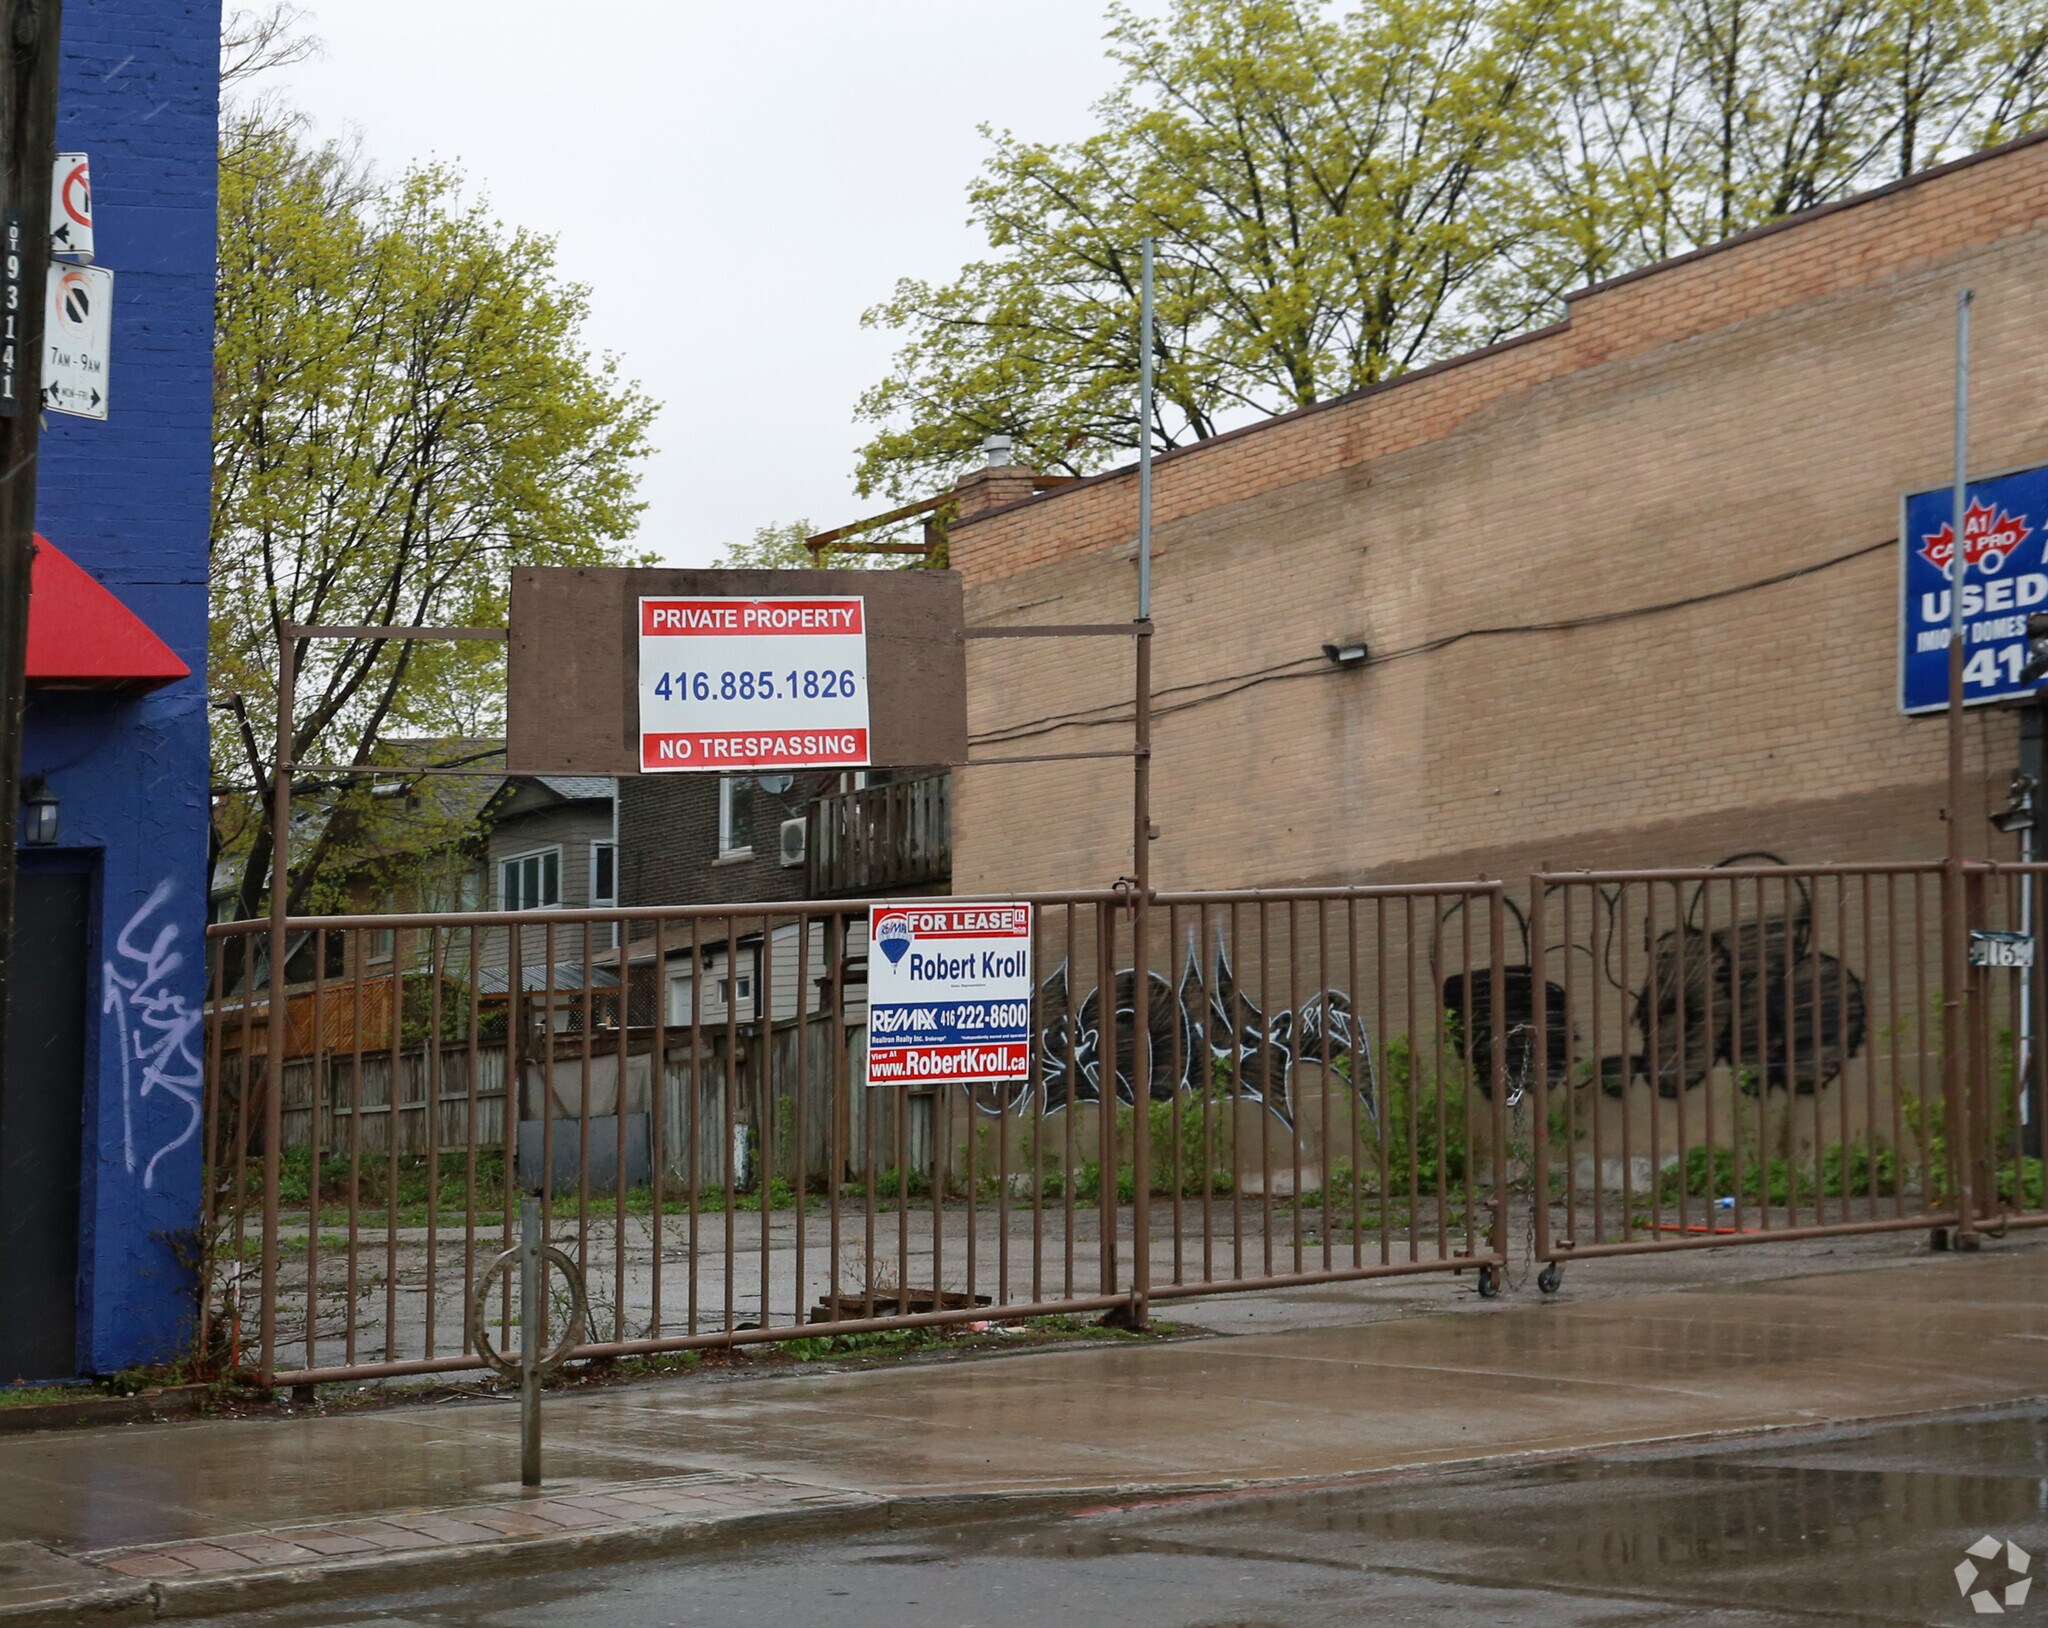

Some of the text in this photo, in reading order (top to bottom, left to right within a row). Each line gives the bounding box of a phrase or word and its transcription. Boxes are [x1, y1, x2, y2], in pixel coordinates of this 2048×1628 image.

[1965, 515, 1988, 536] A1
[1976, 531, 2017, 551] PRO
[1922, 573, 2048, 623] USED
[652, 608, 854, 628] PRIVATE PROPERTY
[654, 669, 856, 701] 416.885.1826
[659, 735, 856, 759] NO TRESPASSING
[908, 914, 947, 931] FOR
[952, 911, 1013, 931] LEASE
[910, 950, 1026, 981] Robert Kroll
[872, 1003, 1027, 1032] RE/MAX 416 222-8600
[871, 1047, 1026, 1077] www.RobertKroll.ca
